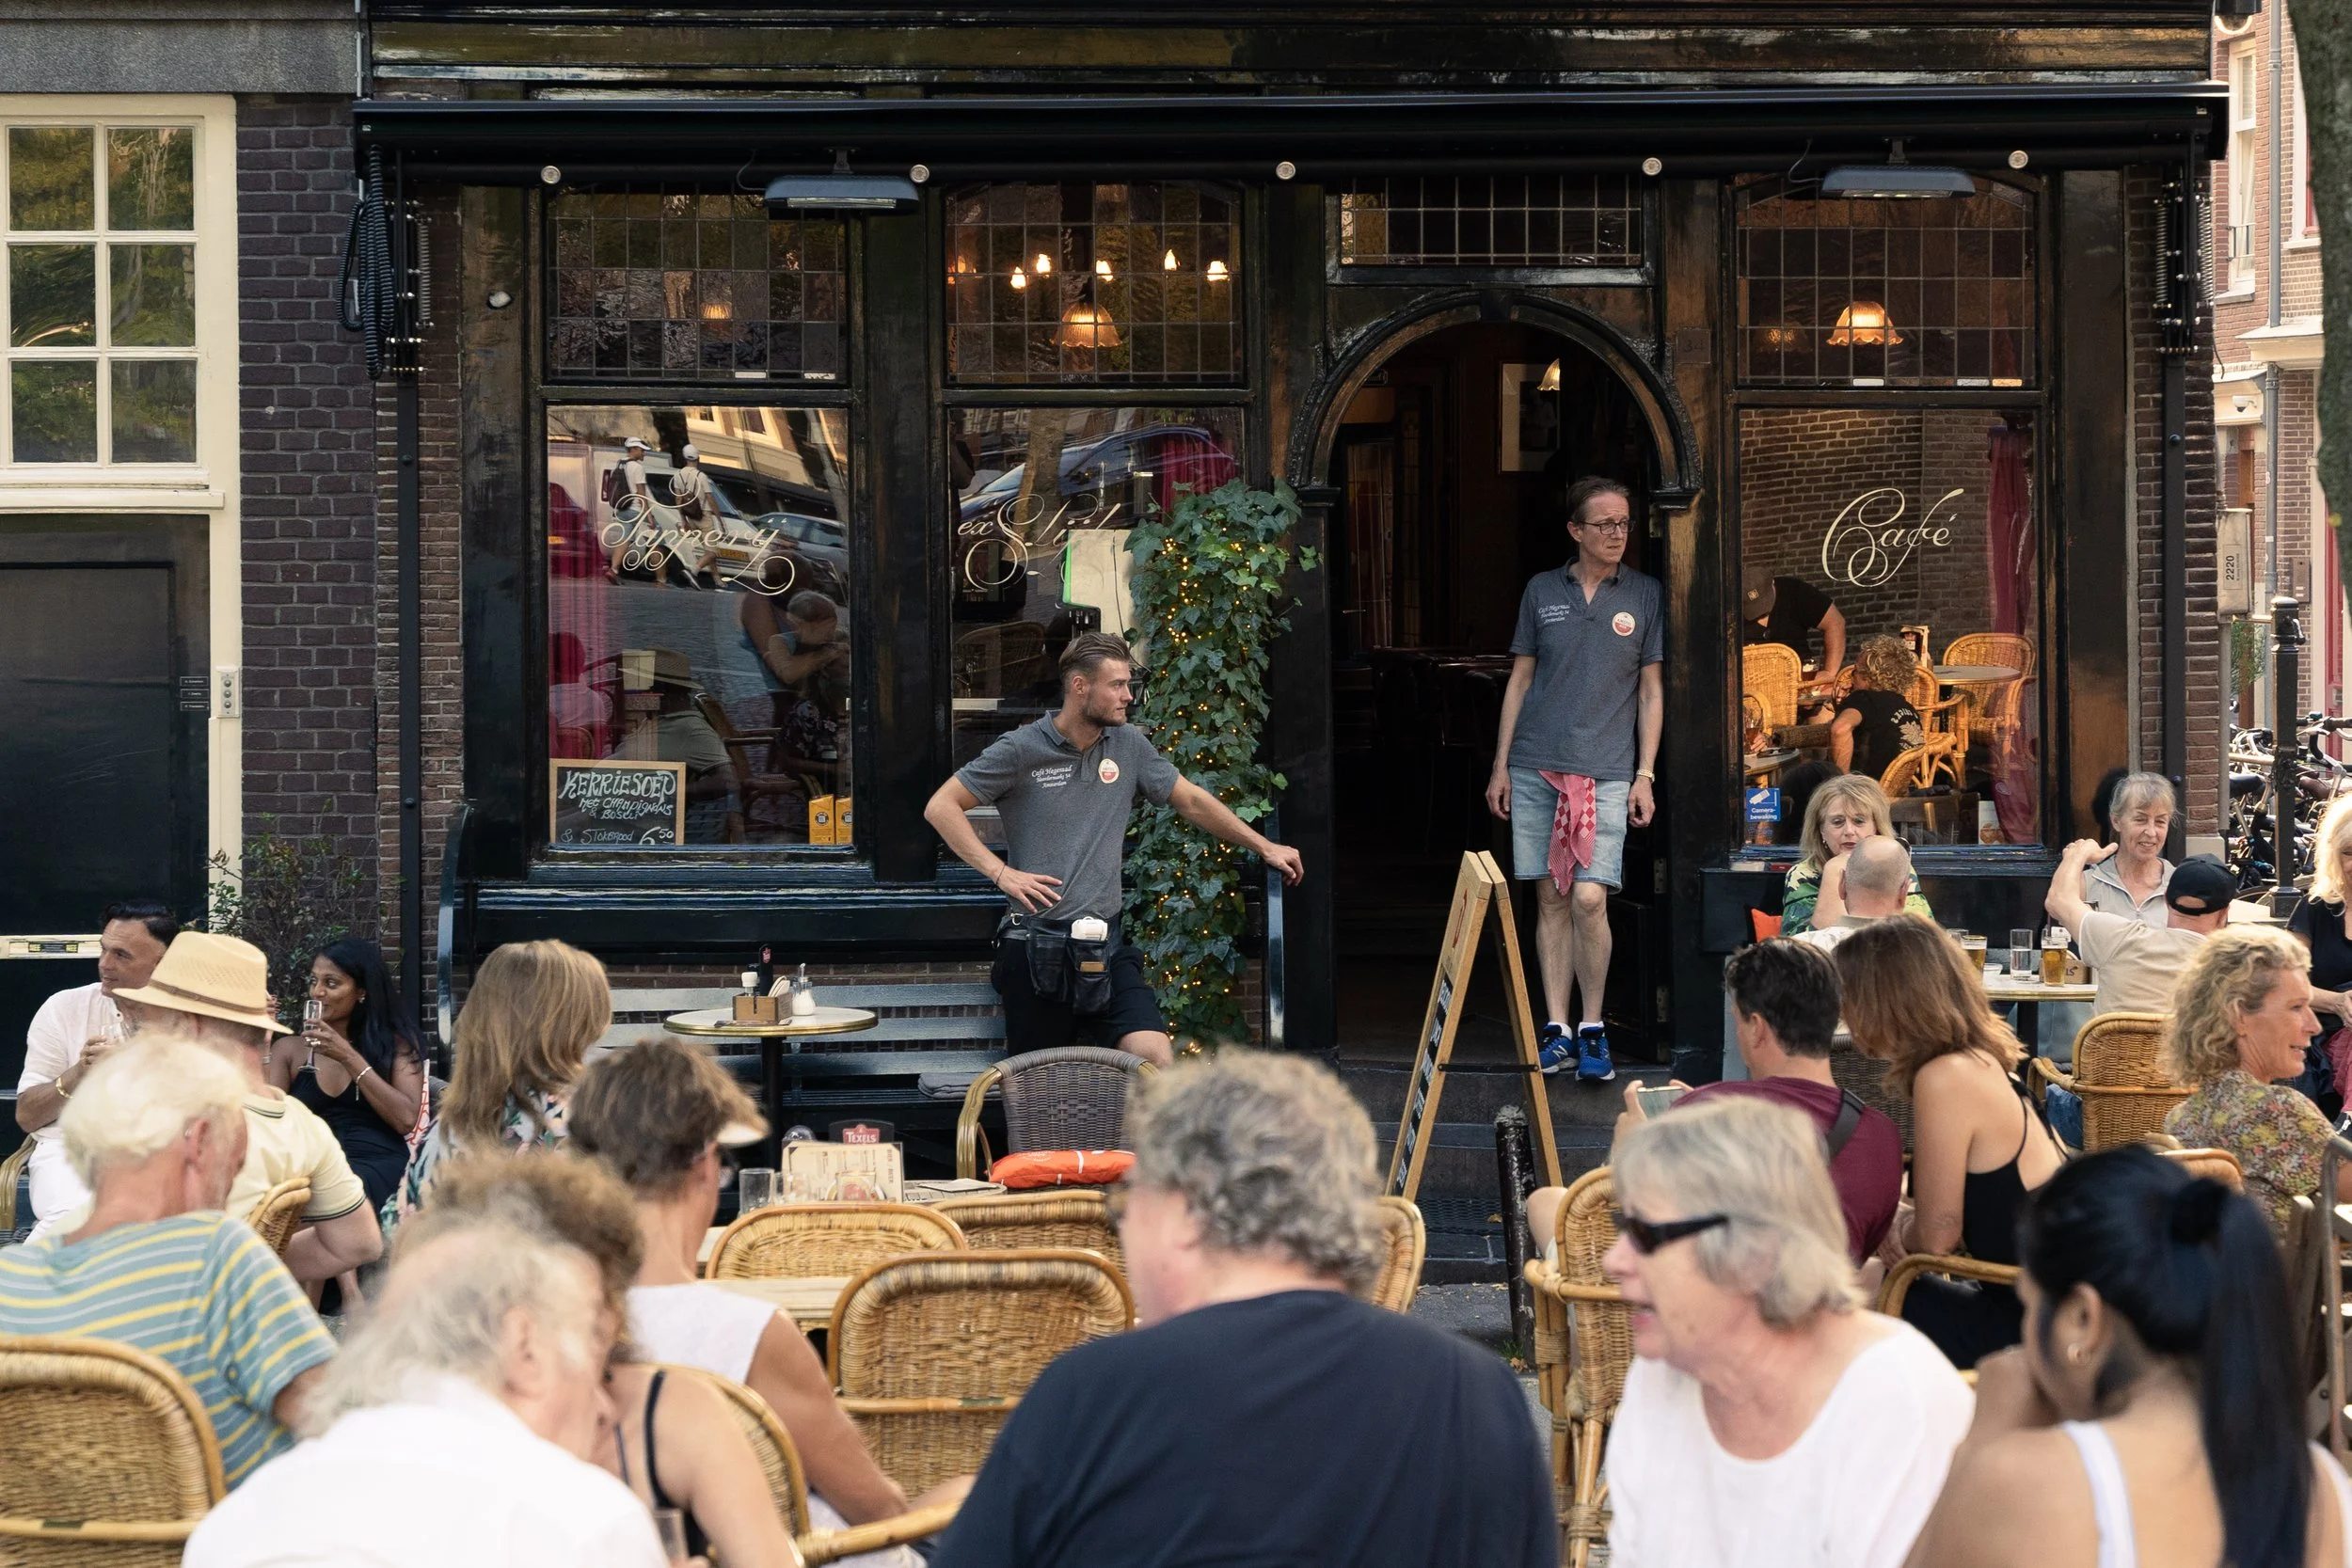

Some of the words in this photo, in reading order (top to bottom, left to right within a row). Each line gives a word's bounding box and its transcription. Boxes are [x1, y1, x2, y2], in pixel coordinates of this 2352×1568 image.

[1821, 487, 1964, 588] Café
[2225, 555, 2235, 580] 2220
[561, 829, 573, 843] &
